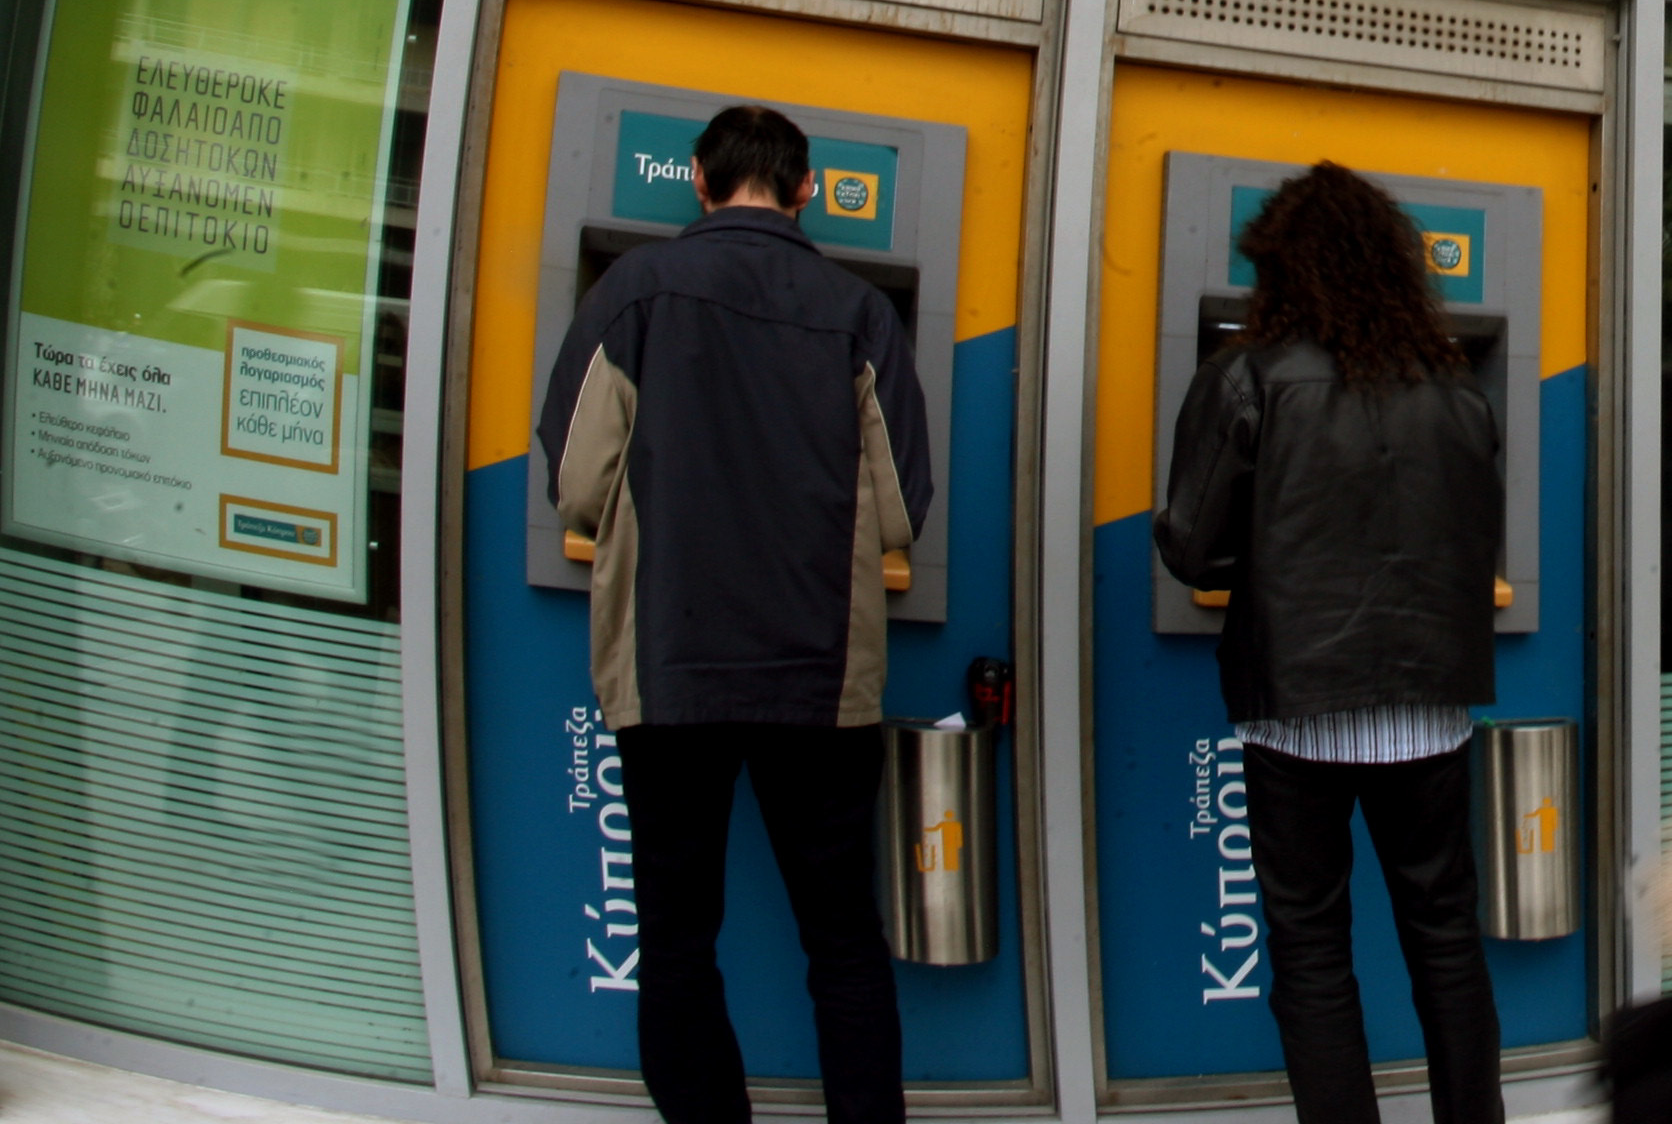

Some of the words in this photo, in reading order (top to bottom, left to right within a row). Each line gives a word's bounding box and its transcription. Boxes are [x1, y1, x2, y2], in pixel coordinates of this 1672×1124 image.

[136, 56, 288, 109] ΕΛΕΥΘΕΡΟΚΕ
[132, 91, 282, 145] ΦΑΛΑΙΟΑΠΟ
[127, 128, 277, 181] ΔΟΣΗΤΟΚΩΝ
[634, 152, 696, 183] Τράπ
[121, 164, 274, 218] ΑΥΞΑΝΟΜΕΝ
[119, 200, 269, 254] ΟΕΠΙΤΟΚΙΟ
[34, 342, 74, 366] Τώρα
[78, 355, 95, 369] τα
[99, 356, 137, 382] έχεις
[142, 365, 171, 385] όλα
[240, 361, 325, 391] λογαριασμός
[241, 346, 325, 372] προθεσμιακός
[33, 368, 72, 394] ΚΑΘΕ
[76, 377, 120, 404] ΜΗΝΑ
[124, 387, 167, 413] ΜΑΖΙ.
[240, 389, 323, 418] επιπλέον
[237, 414, 277, 437] κάθε
[282, 423, 323, 445] μήνα
[566, 706, 597, 813] Τράπεζα
[1189, 737, 1218, 839] Τράπεζα
